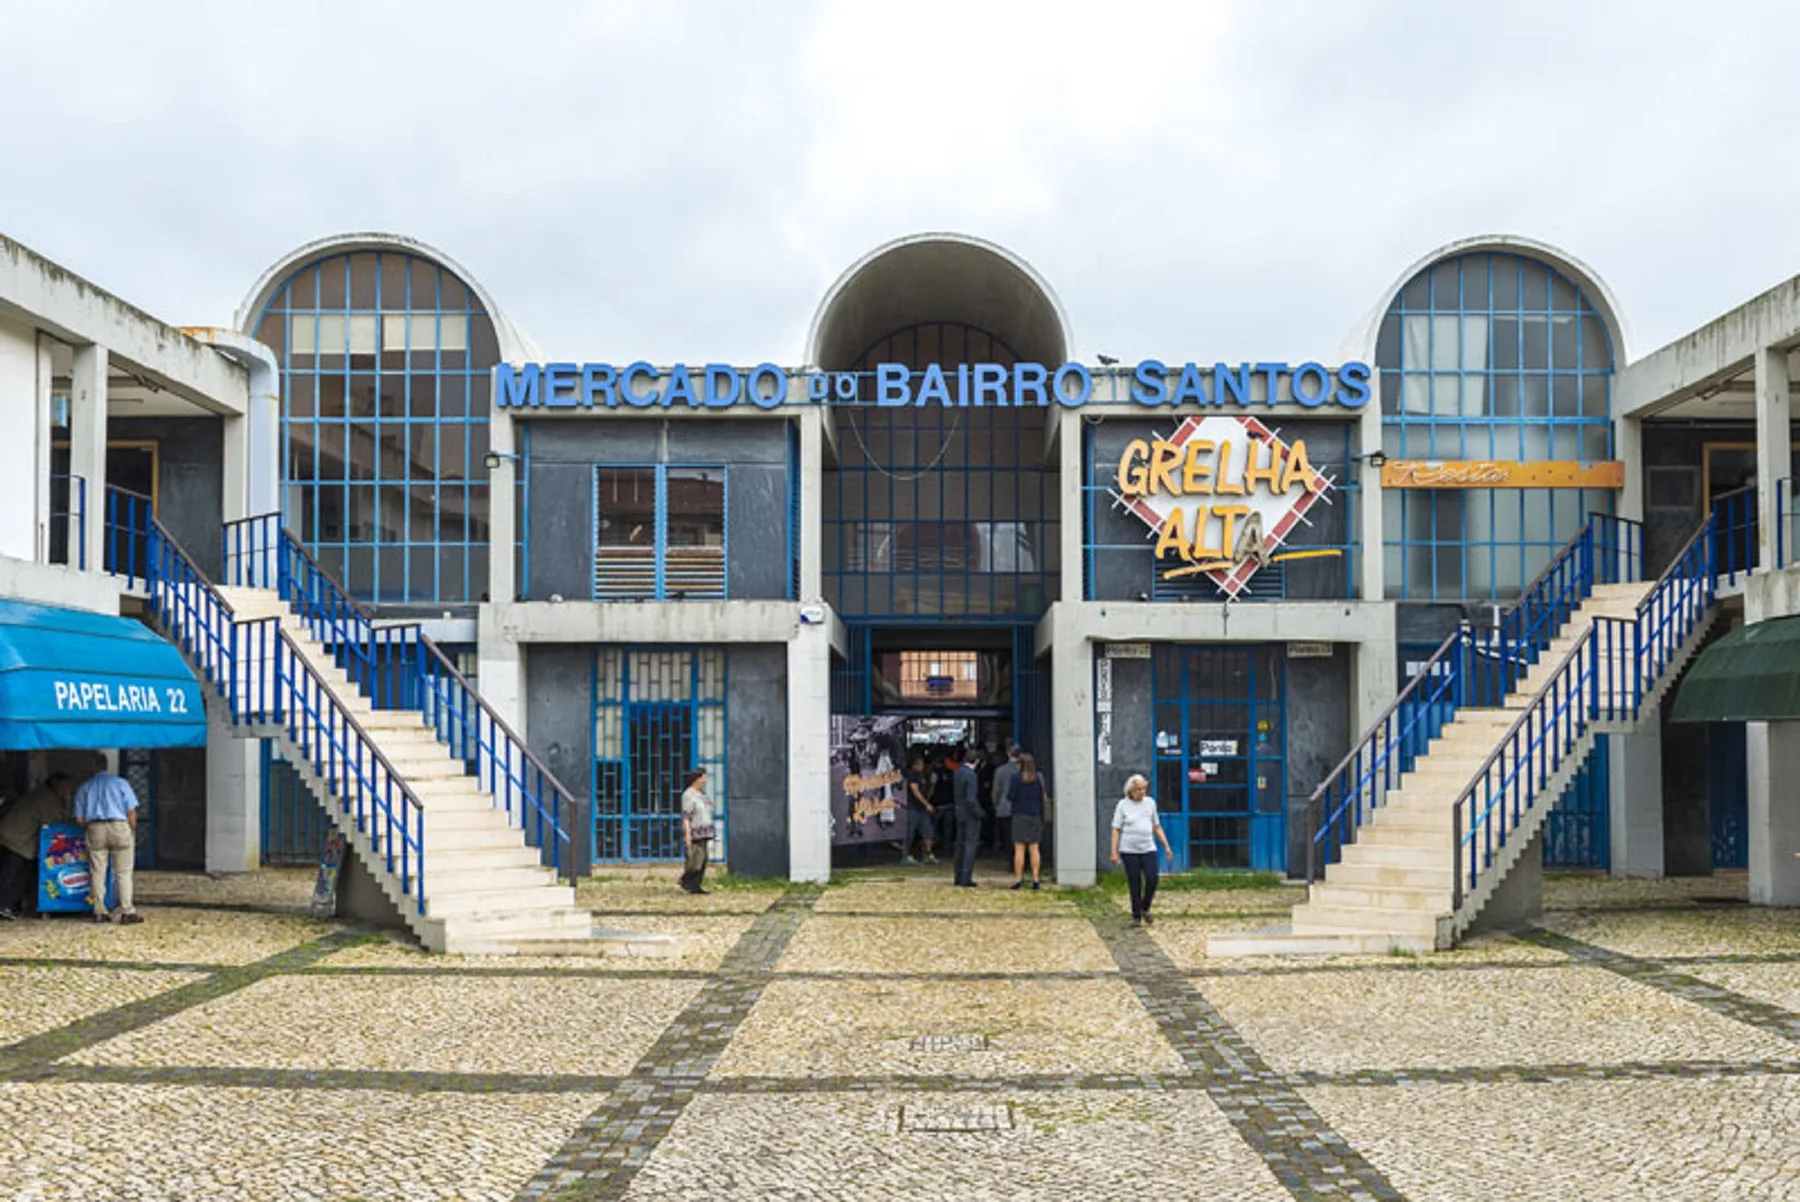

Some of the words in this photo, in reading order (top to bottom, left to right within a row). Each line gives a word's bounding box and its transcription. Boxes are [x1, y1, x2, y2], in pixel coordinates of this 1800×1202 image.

[497, 361, 788, 409] MERCADO
[810, 373, 857, 400] DO
[876, 361, 1093, 409] BAIRRO
[1130, 360, 1373, 409] SANTOS
[1118, 439, 1318, 496] GRELHA
[1155, 504, 1270, 568] ALTA
[54, 681, 162, 712] PAPELARIA
[166, 688, 188, 713] 22
